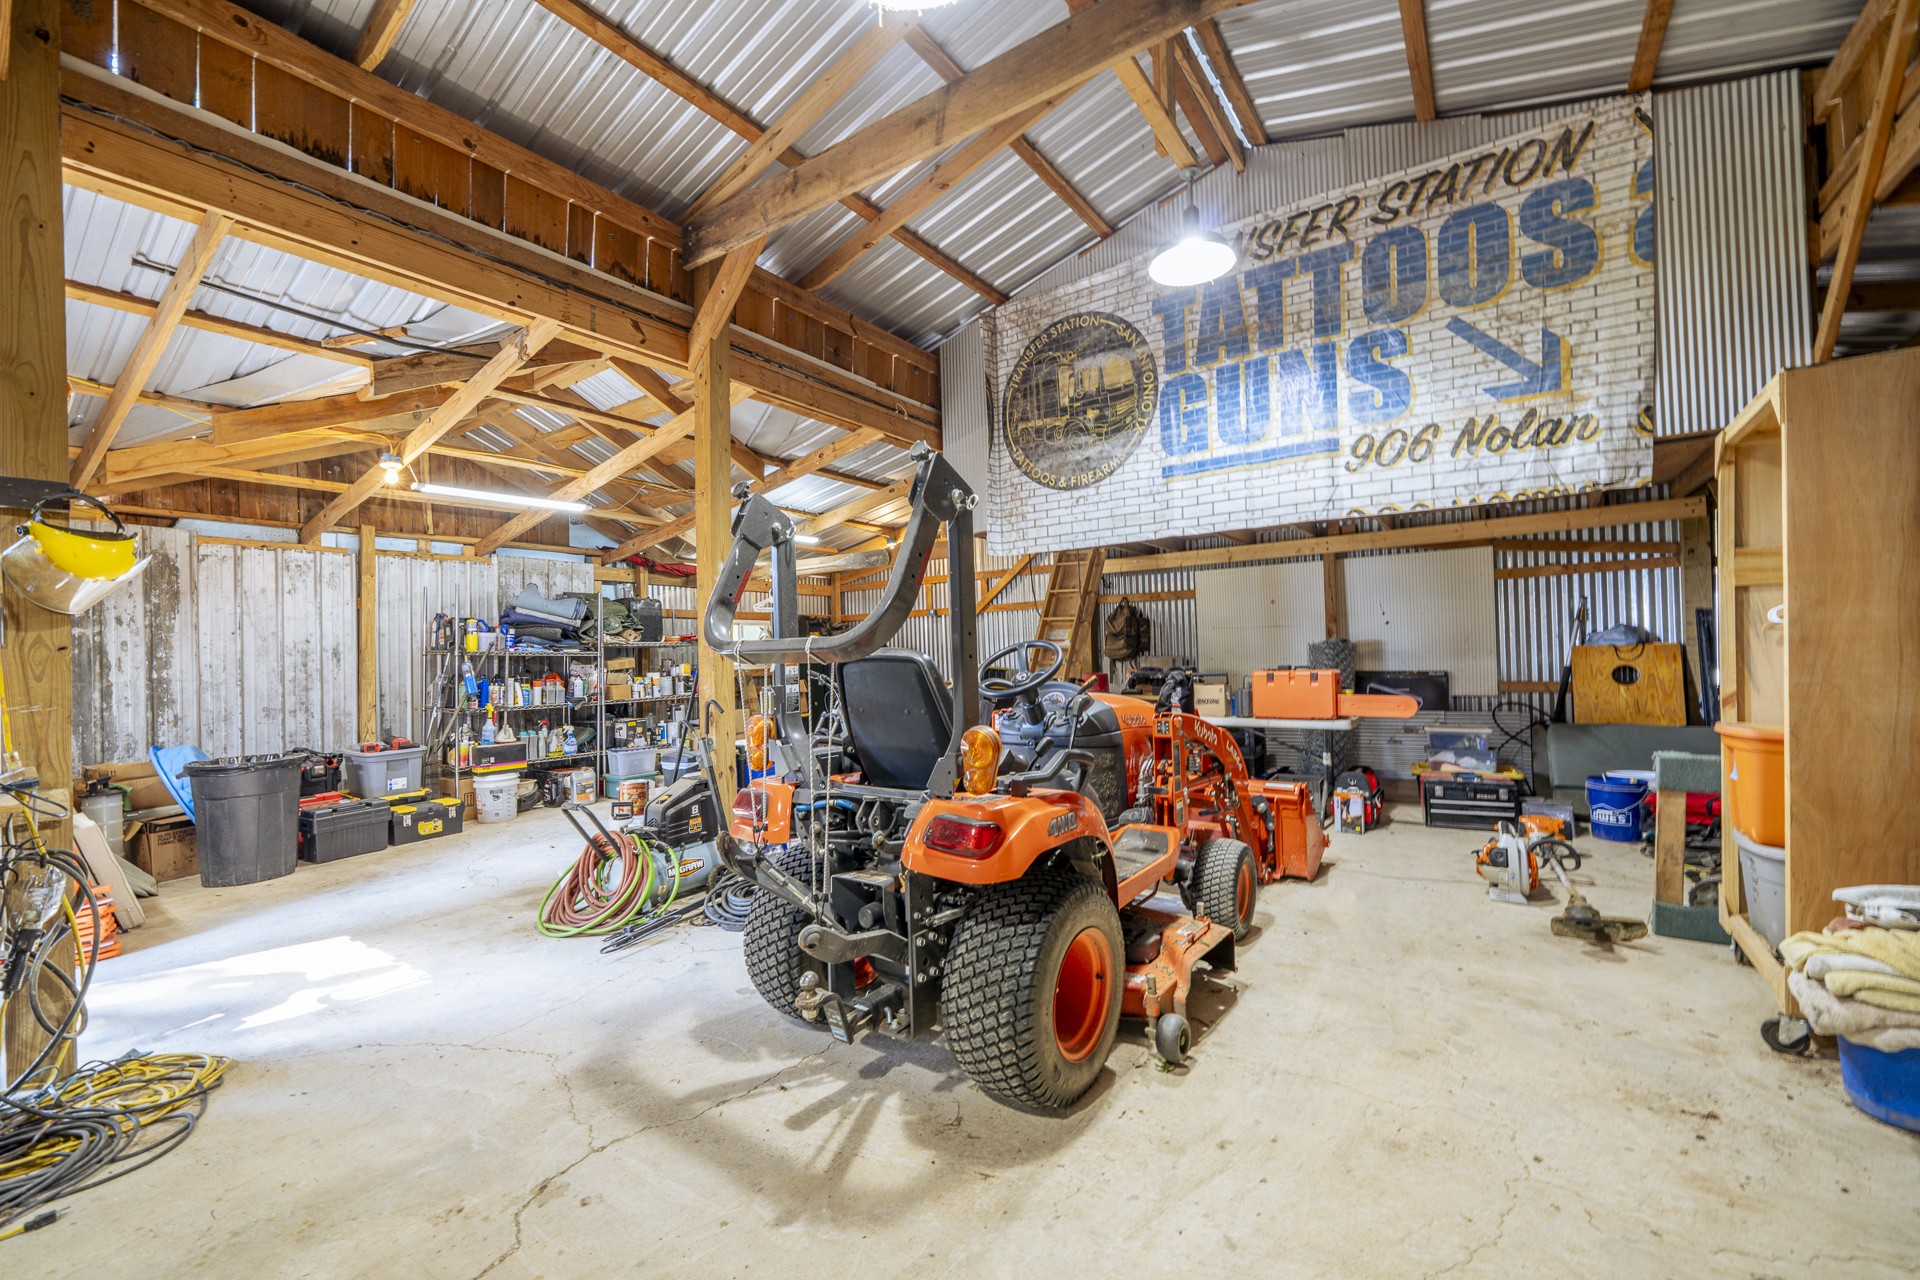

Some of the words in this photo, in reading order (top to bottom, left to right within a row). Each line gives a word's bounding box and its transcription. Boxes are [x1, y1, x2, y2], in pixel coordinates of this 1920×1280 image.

[1234, 199, 1362, 264] NSFER
[1370, 119, 1597, 226] STATION
[1151, 177, 1605, 377] TATTOOS
[1010, 335, 1049, 389] TRANSFER
[1050, 315, 1101, 339] STATION
[1116, 323, 1140, 348] SAN
[1136, 348, 1156, 413] ANTONIO
[1159, 327, 1417, 457] GUNS
[1133, 416, 1149, 434] TX
[1344, 422, 1442, 473] 906
[1450, 407, 1601, 459] Nolan
[1013, 448, 1057, 487] TATTOOS
[1058, 477, 1068, 488] &
[1070, 452, 1127, 488] FIREARMS
[1121, 710, 1147, 727] Kubota
[1194, 718, 1218, 746] Kubota
[691, 804, 699, 814] 8
[1047, 810, 1078, 837] 4WD
[667, 859, 705, 878] MGRAW
